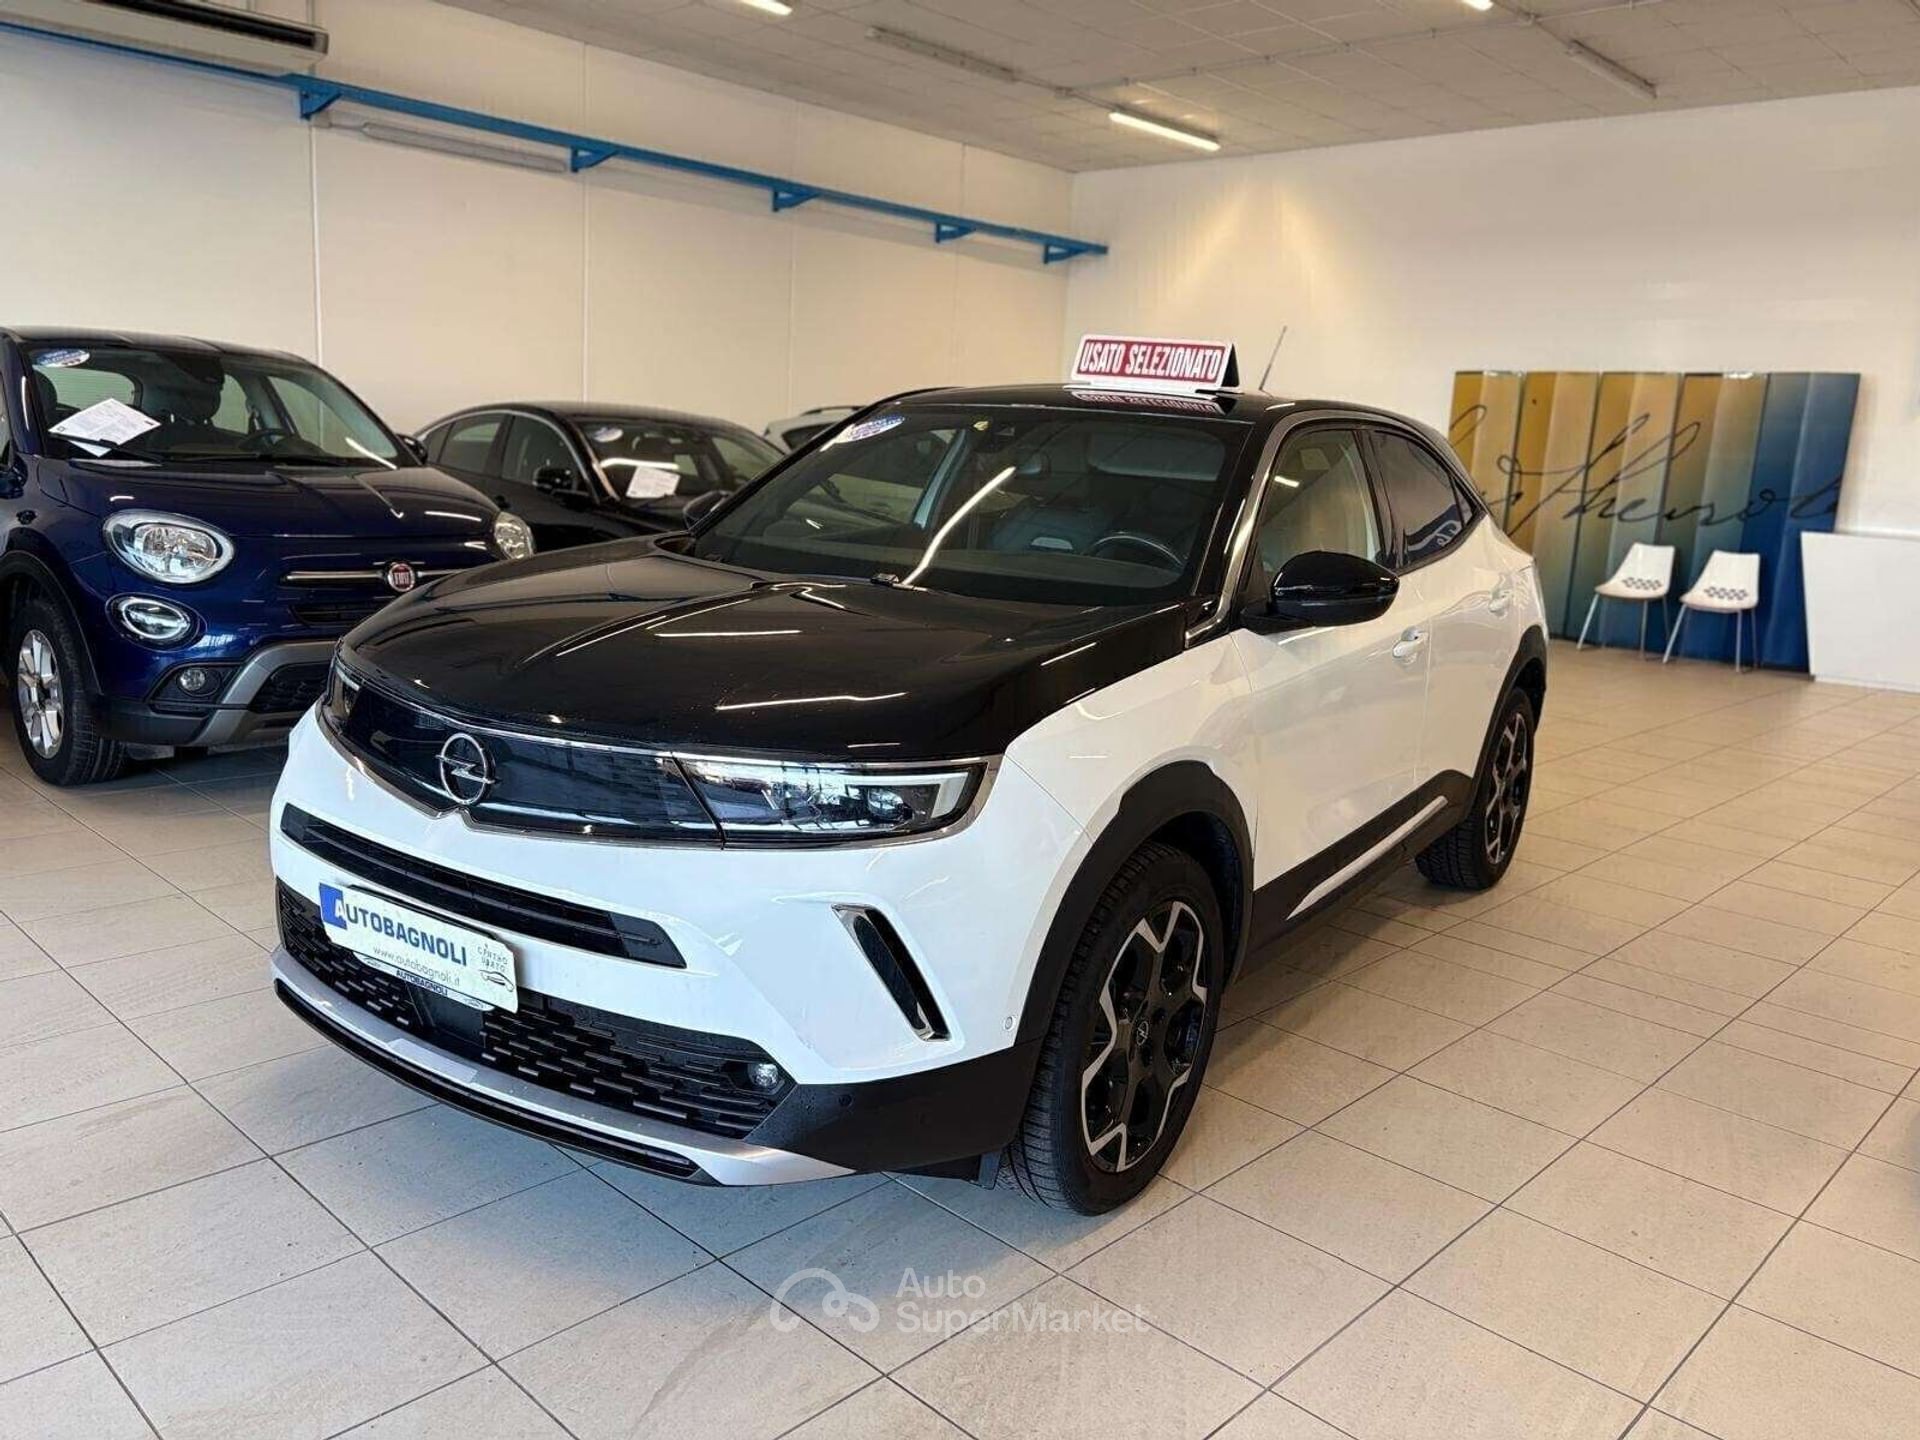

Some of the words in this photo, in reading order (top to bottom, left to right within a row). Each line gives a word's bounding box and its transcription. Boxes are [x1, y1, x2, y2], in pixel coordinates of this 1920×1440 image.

[1079, 341, 1127, 374] USATO
[1124, 343, 1223, 380] SELEZIONATO
[393, 572, 410, 585] FIAT
[333, 897, 468, 967] AUTOBAGNOLI
[395, 968, 448, 996] AUTOBAGNOLI
